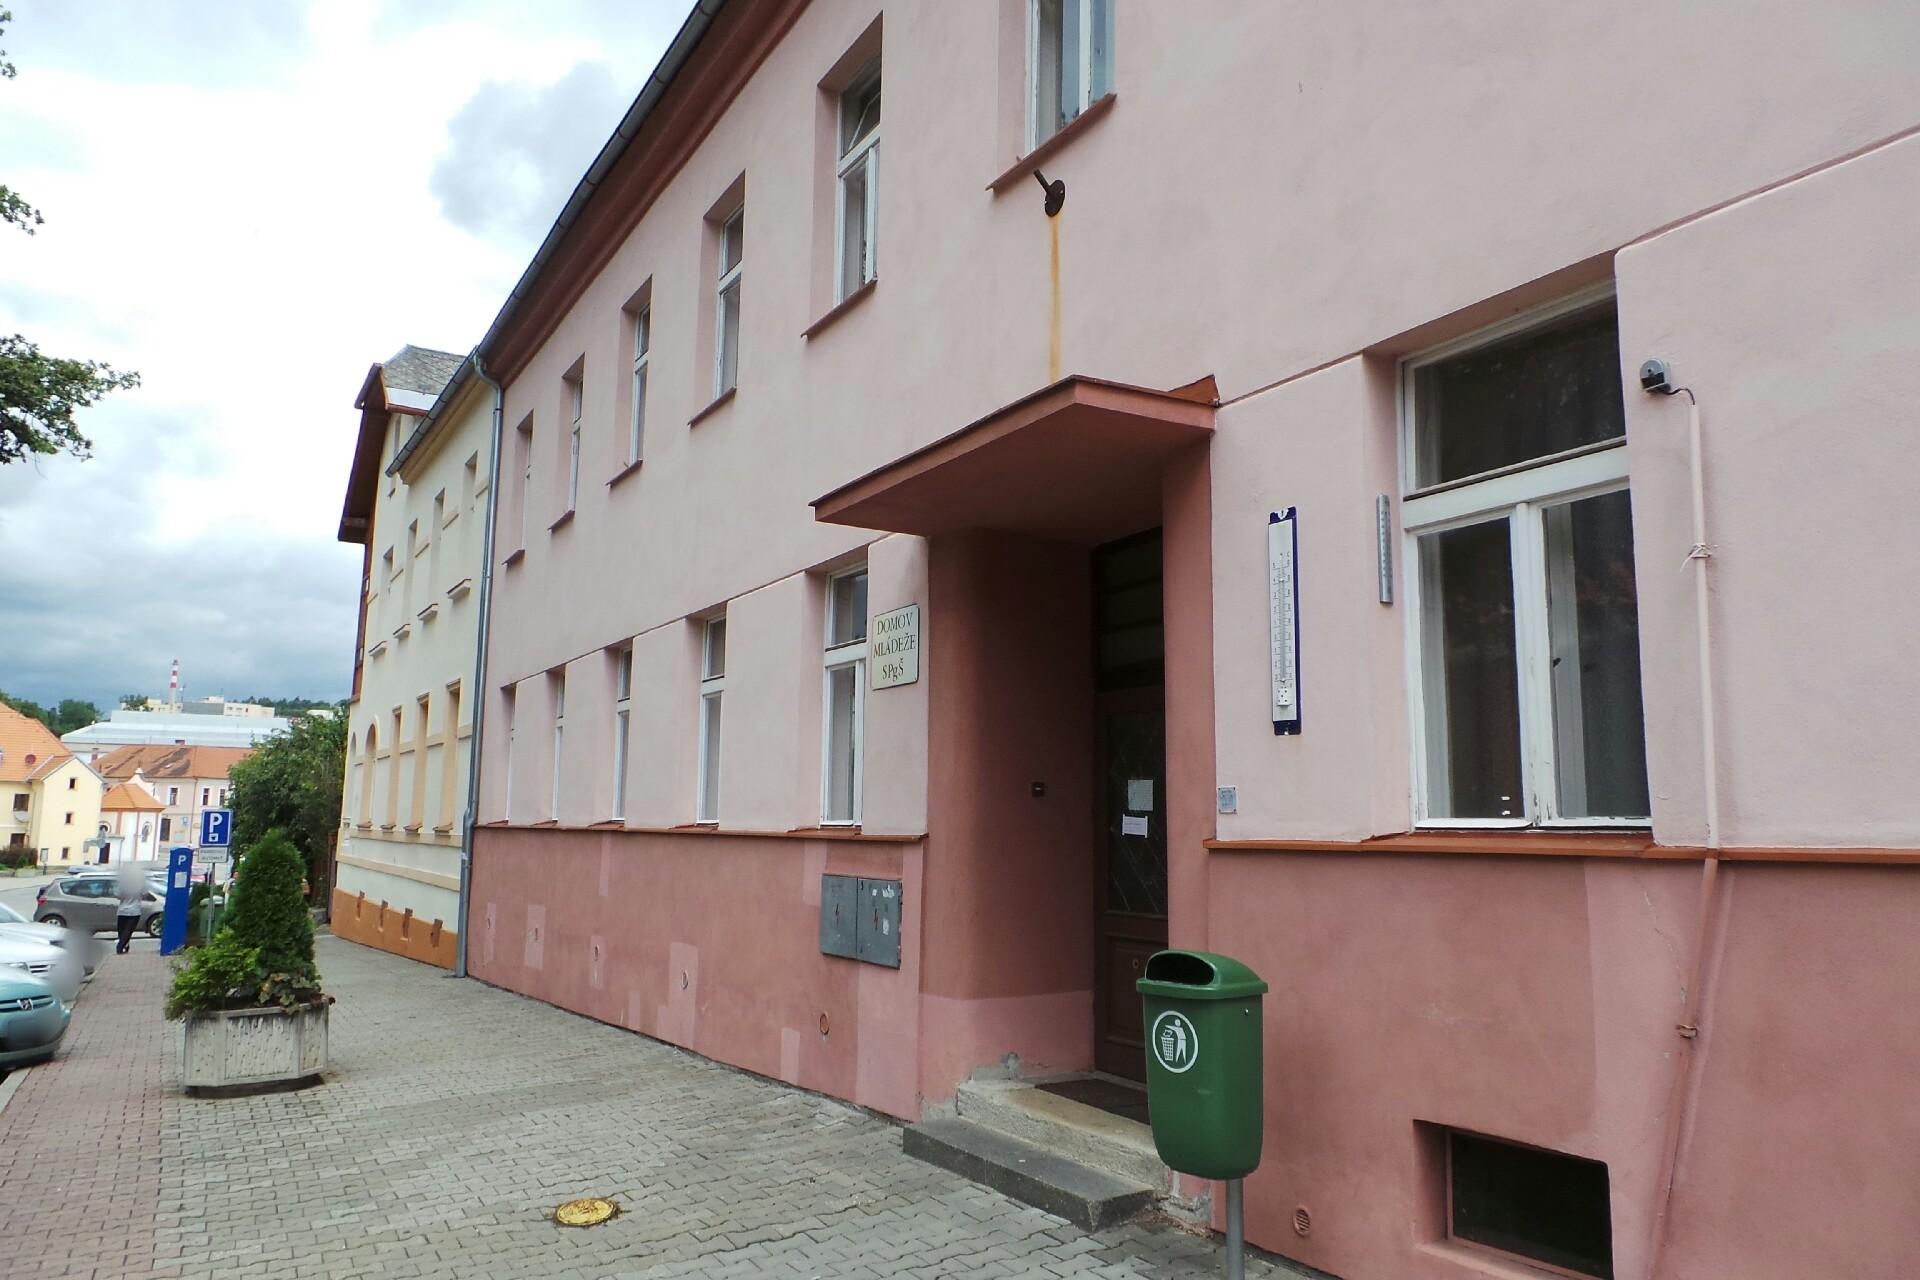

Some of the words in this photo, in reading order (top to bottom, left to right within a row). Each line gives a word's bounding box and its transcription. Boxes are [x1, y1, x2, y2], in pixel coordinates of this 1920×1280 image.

[877, 612, 913, 635] DOMOV
[873, 632, 916, 658] MLÁDEŽE
[882, 657, 904, 682] SPgŠ
[209, 812, 223, 833] P
[178, 855, 187, 866] P
